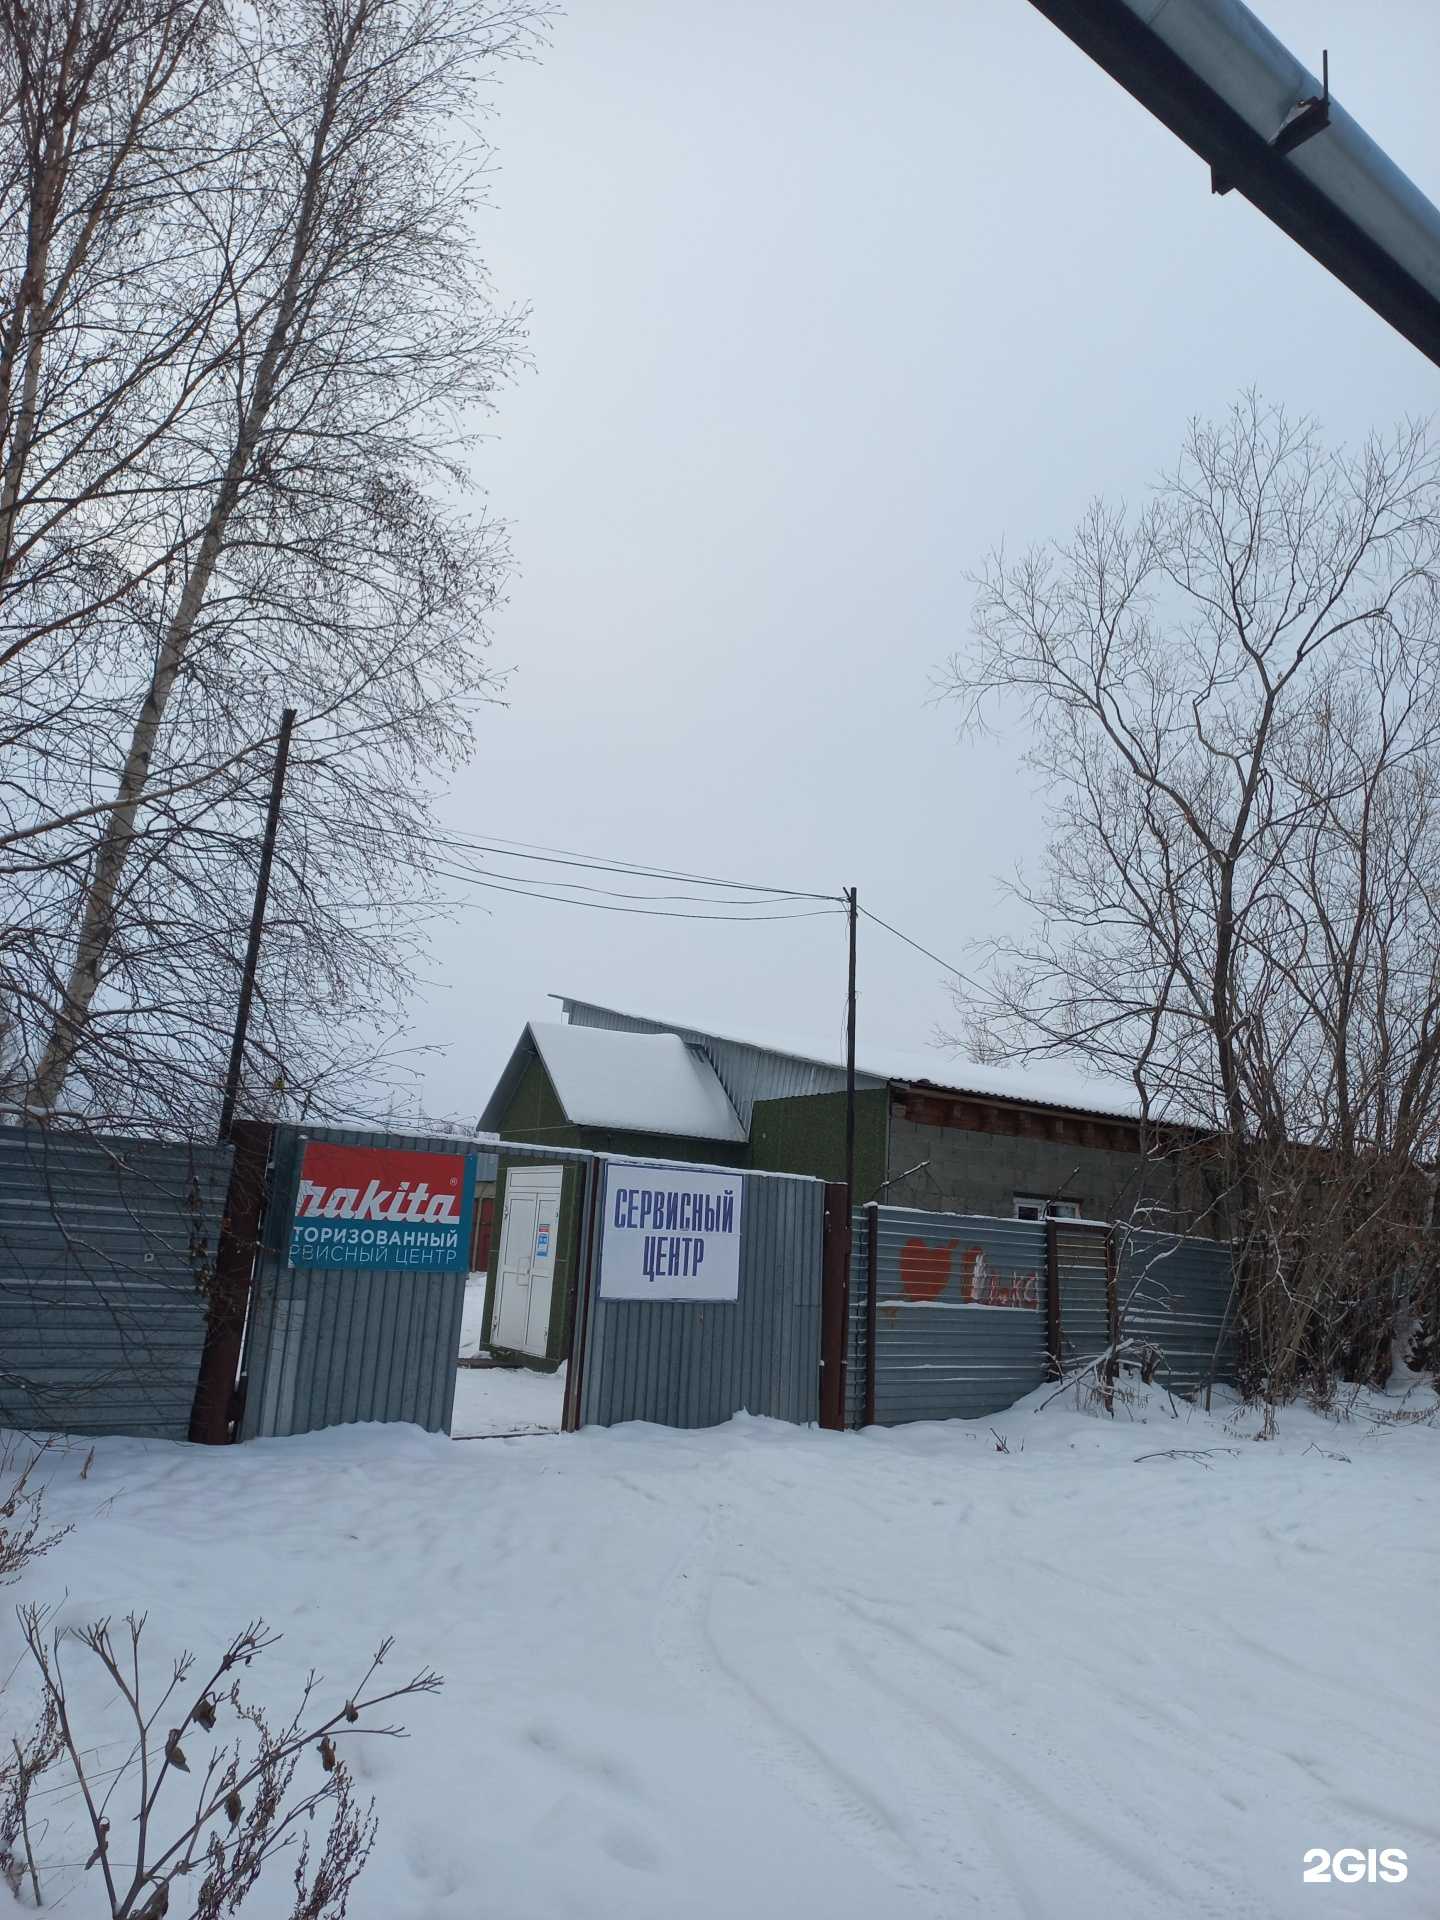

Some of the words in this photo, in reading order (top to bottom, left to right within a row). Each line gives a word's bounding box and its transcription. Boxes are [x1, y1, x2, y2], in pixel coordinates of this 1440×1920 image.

[614, 1189, 734, 1233] СЕРВИСНЫЙ
[395, 1249, 457, 1265] ЦЕНТР
[643, 1236, 705, 1282] ЦЕНТР
